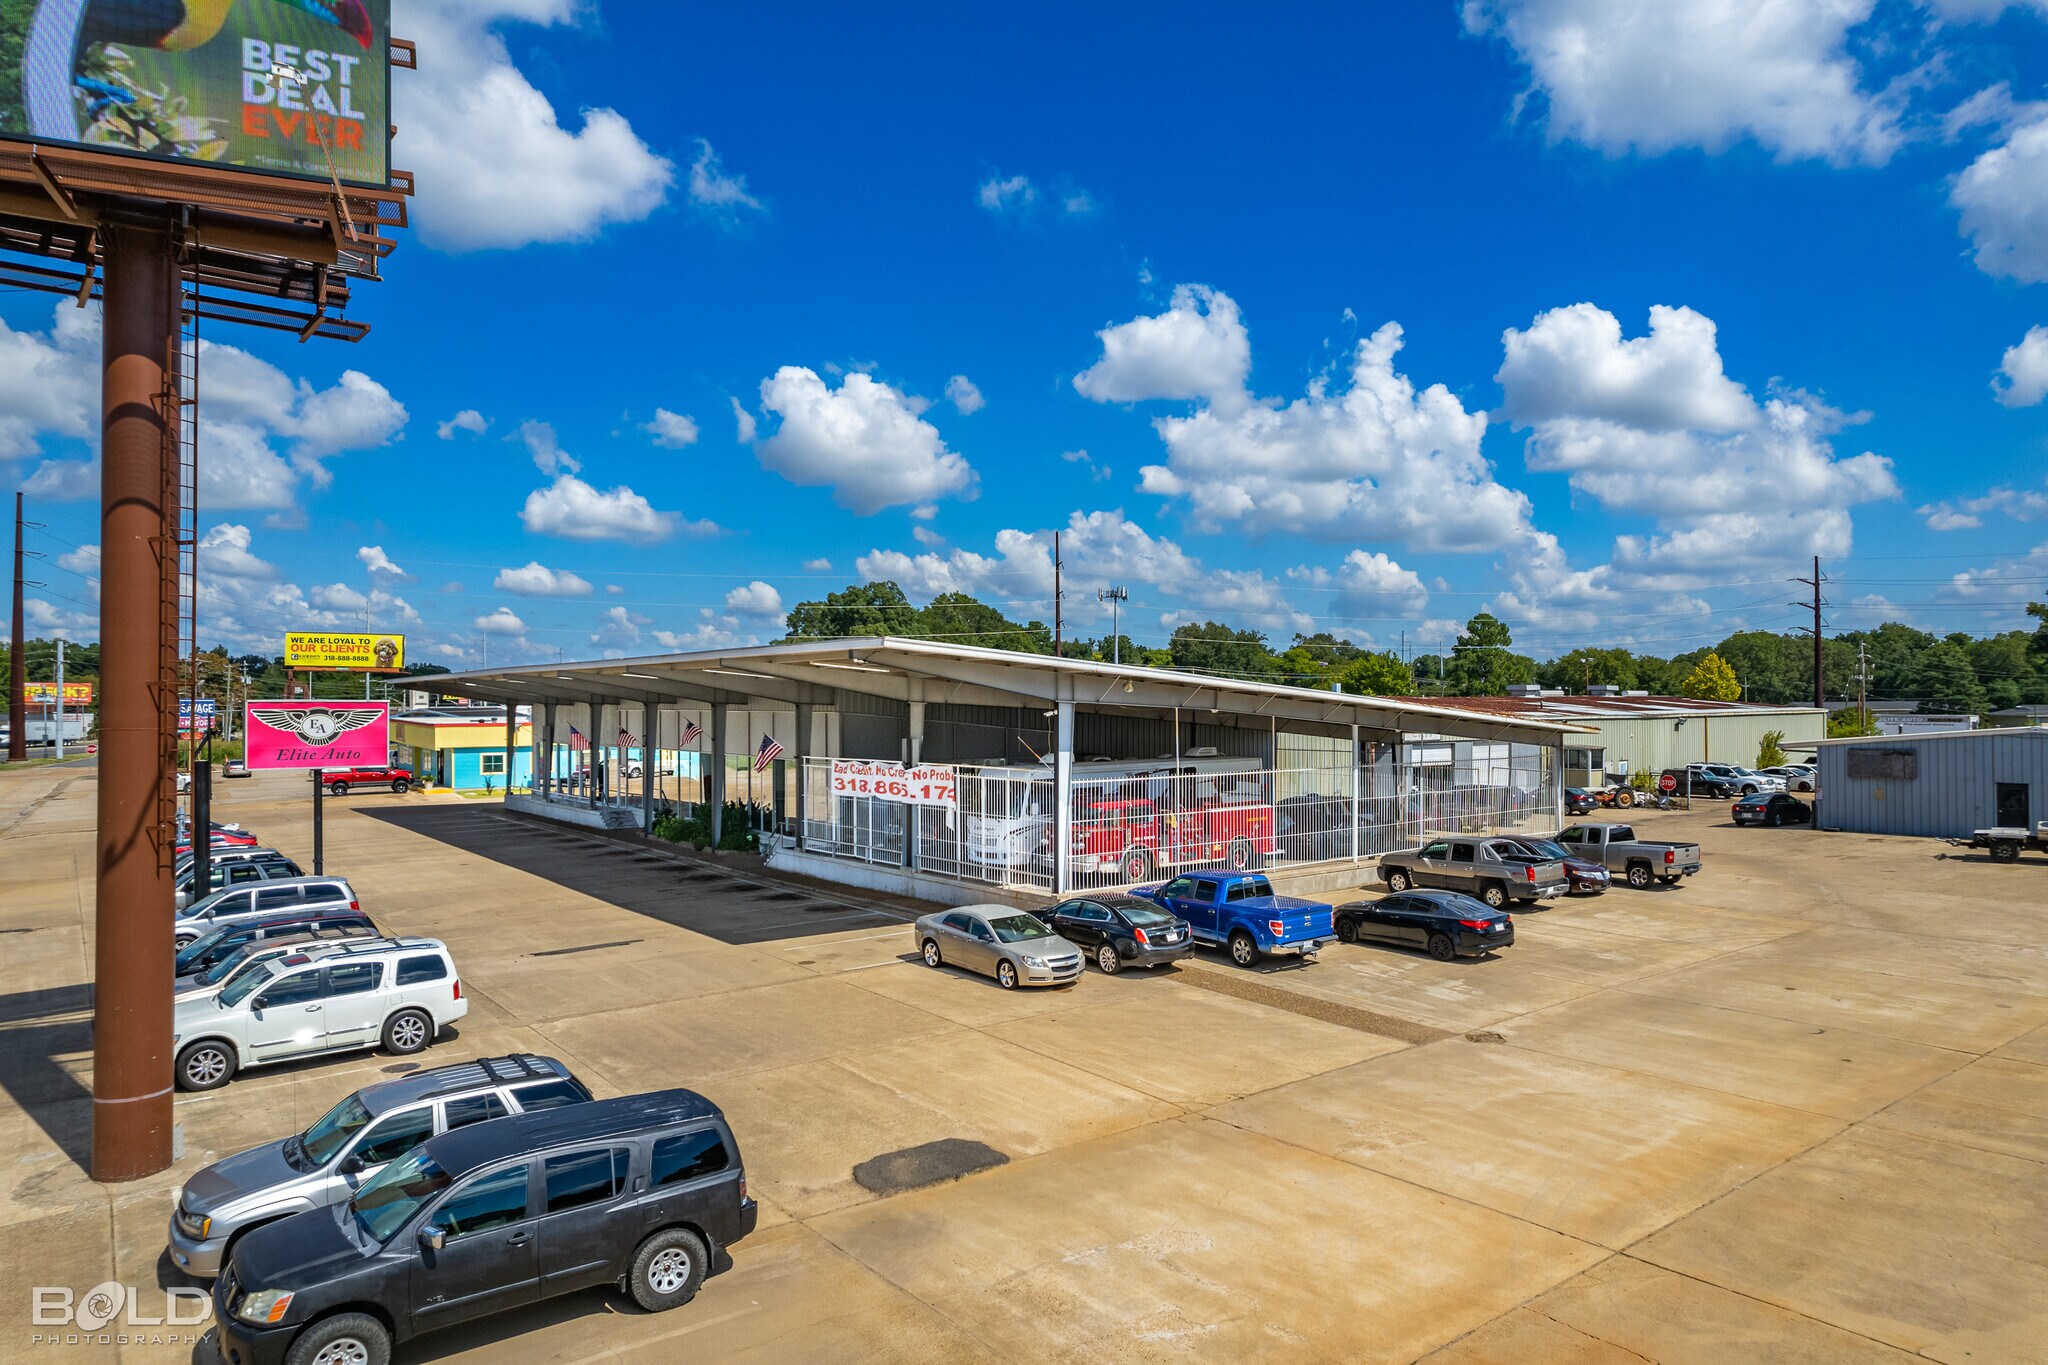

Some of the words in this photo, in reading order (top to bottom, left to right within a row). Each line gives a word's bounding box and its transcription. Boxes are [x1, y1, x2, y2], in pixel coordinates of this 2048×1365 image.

[242, 38, 360, 85] BEST
[242, 70, 365, 120] DEAL
[242, 103, 364, 152] EVER
[290, 644, 316, 652] OUR
[320, 645, 370, 653] CLIENTS
[276, 748, 317, 761] Elite
[321, 747, 361, 760] Auto
[834, 763, 848, 774] Bad
[876, 765, 886, 777] No
[912, 769, 928, 781] No
